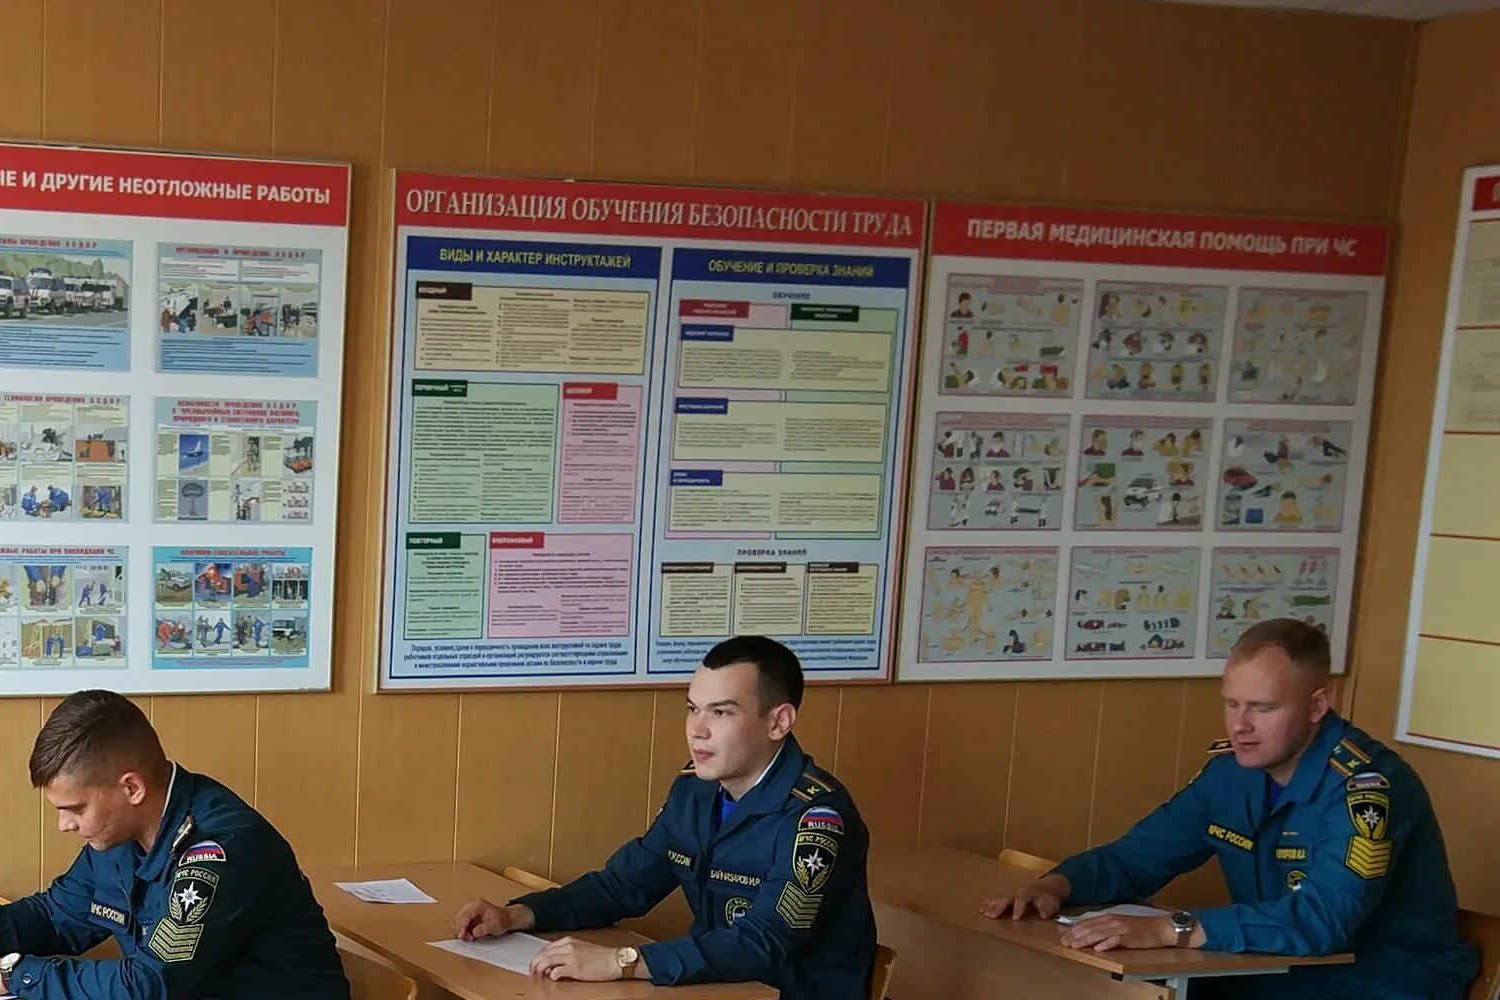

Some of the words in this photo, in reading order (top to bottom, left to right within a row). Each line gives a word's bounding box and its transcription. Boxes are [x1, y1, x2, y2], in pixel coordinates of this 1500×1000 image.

[22, 170, 36, 188] И
[40, 171, 114, 193] ДРУГИЕ
[119, 176, 253, 201] НЕОТЛОЖНЫЕ
[257, 184, 331, 205] РАБОТЫ
[405, 188, 567, 223] ОРГАНИЗАЦИЯ
[572, 197, 684, 226] ОБУЧЕНИЯ
[688, 202, 847, 234] БЕЗОПАСНОСТИ
[852, 211, 913, 239] ТРУДА
[967, 218, 1045, 242] ПЕРВАЯ
[1048, 224, 1196, 250] МЕДИЦИНСКАЯ
[1199, 230, 1287, 255] ПОМОЩЬ
[1290, 234, 1329, 256] ПРИ
[1333, 237, 1358, 257] ЧС
[439, 247, 474, 264] ВИДЫ
[475, 249, 484, 263] И
[485, 250, 542, 266] ХАРАКТЕР
[544, 251, 631, 269] ИНСТРУКТАЖЕЙ
[708, 259, 764, 275] ОБУЧЕНИЕ
[766, 262, 774, 274] И
[775, 262, 831, 277] ПРОВЕРКА
[832, 264, 874, 278] ЗНАНИЙ
[808, 821, 838, 830] RUSSIA
[187, 853, 217, 862] RUSSIA
